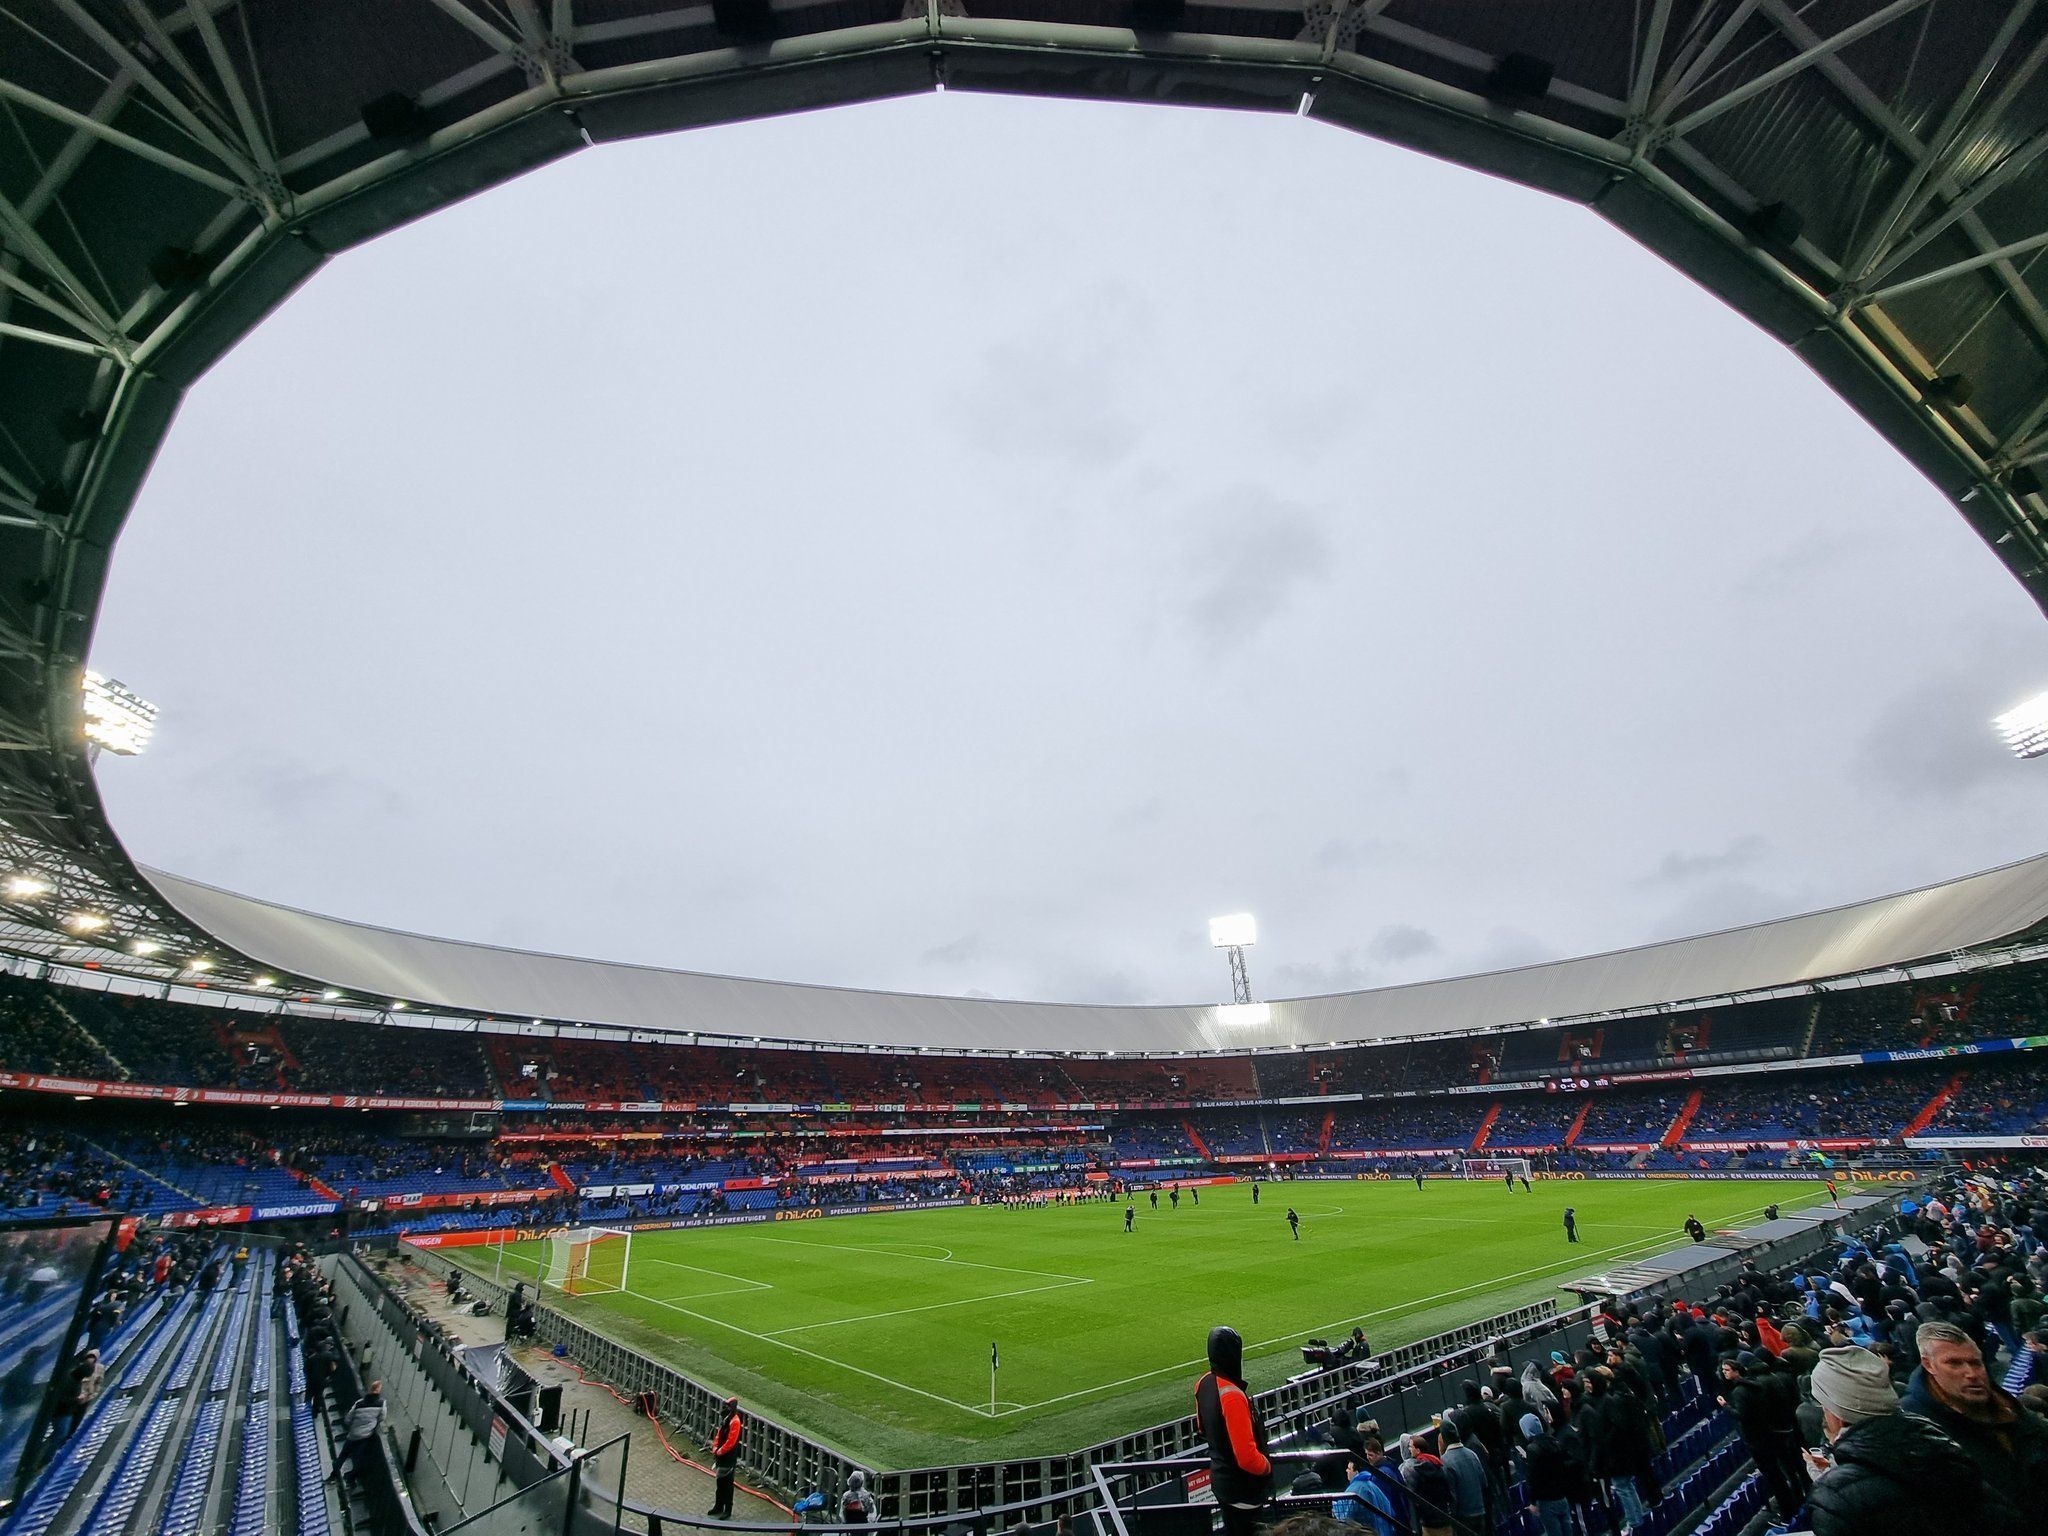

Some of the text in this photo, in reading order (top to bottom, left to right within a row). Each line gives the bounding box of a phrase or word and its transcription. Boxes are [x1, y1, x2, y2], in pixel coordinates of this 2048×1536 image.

[1890, 1048, 1944, 1061] Heineken
[1670, 1070, 1691, 1078] Airport
[262, 1094, 279, 1103] CUP
[280, 1095, 298, 1104] 1974
[665, 1104, 685, 1112] ING
[830, 1207, 861, 1216] SPECIALIST
[632, 1221, 672, 1231] ONDERHOUD
[672, 1220, 686, 1228] VAN
[705, 1218, 714, 1226] EN
[714, 1215, 767, 1224] HEFWERKTUIGEN
